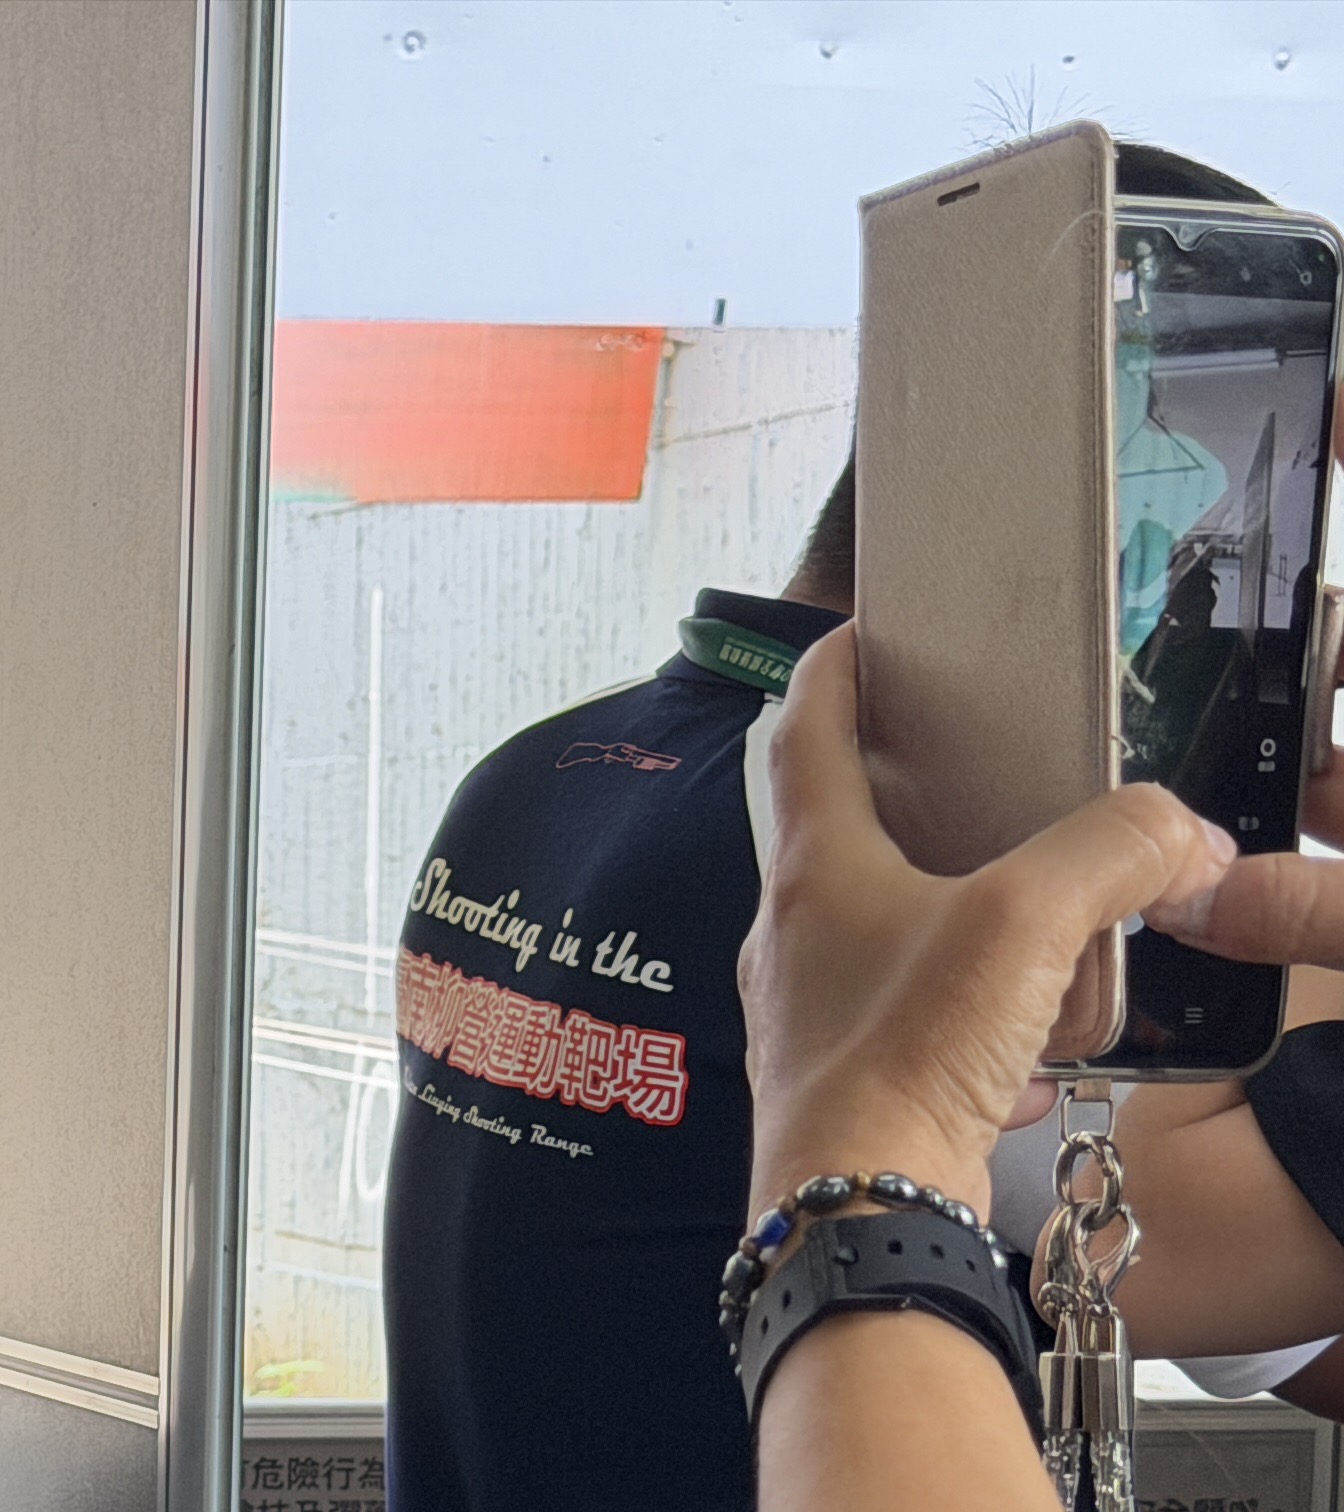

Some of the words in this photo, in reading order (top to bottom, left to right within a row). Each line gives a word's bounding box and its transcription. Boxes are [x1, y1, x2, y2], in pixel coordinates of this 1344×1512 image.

[410, 857, 543, 972] Shooting
[549, 907, 582, 967] in
[591, 931, 674, 993] the
[463, 1104, 522, 1144] Shooting
[530, 1123, 594, 1158] Range
